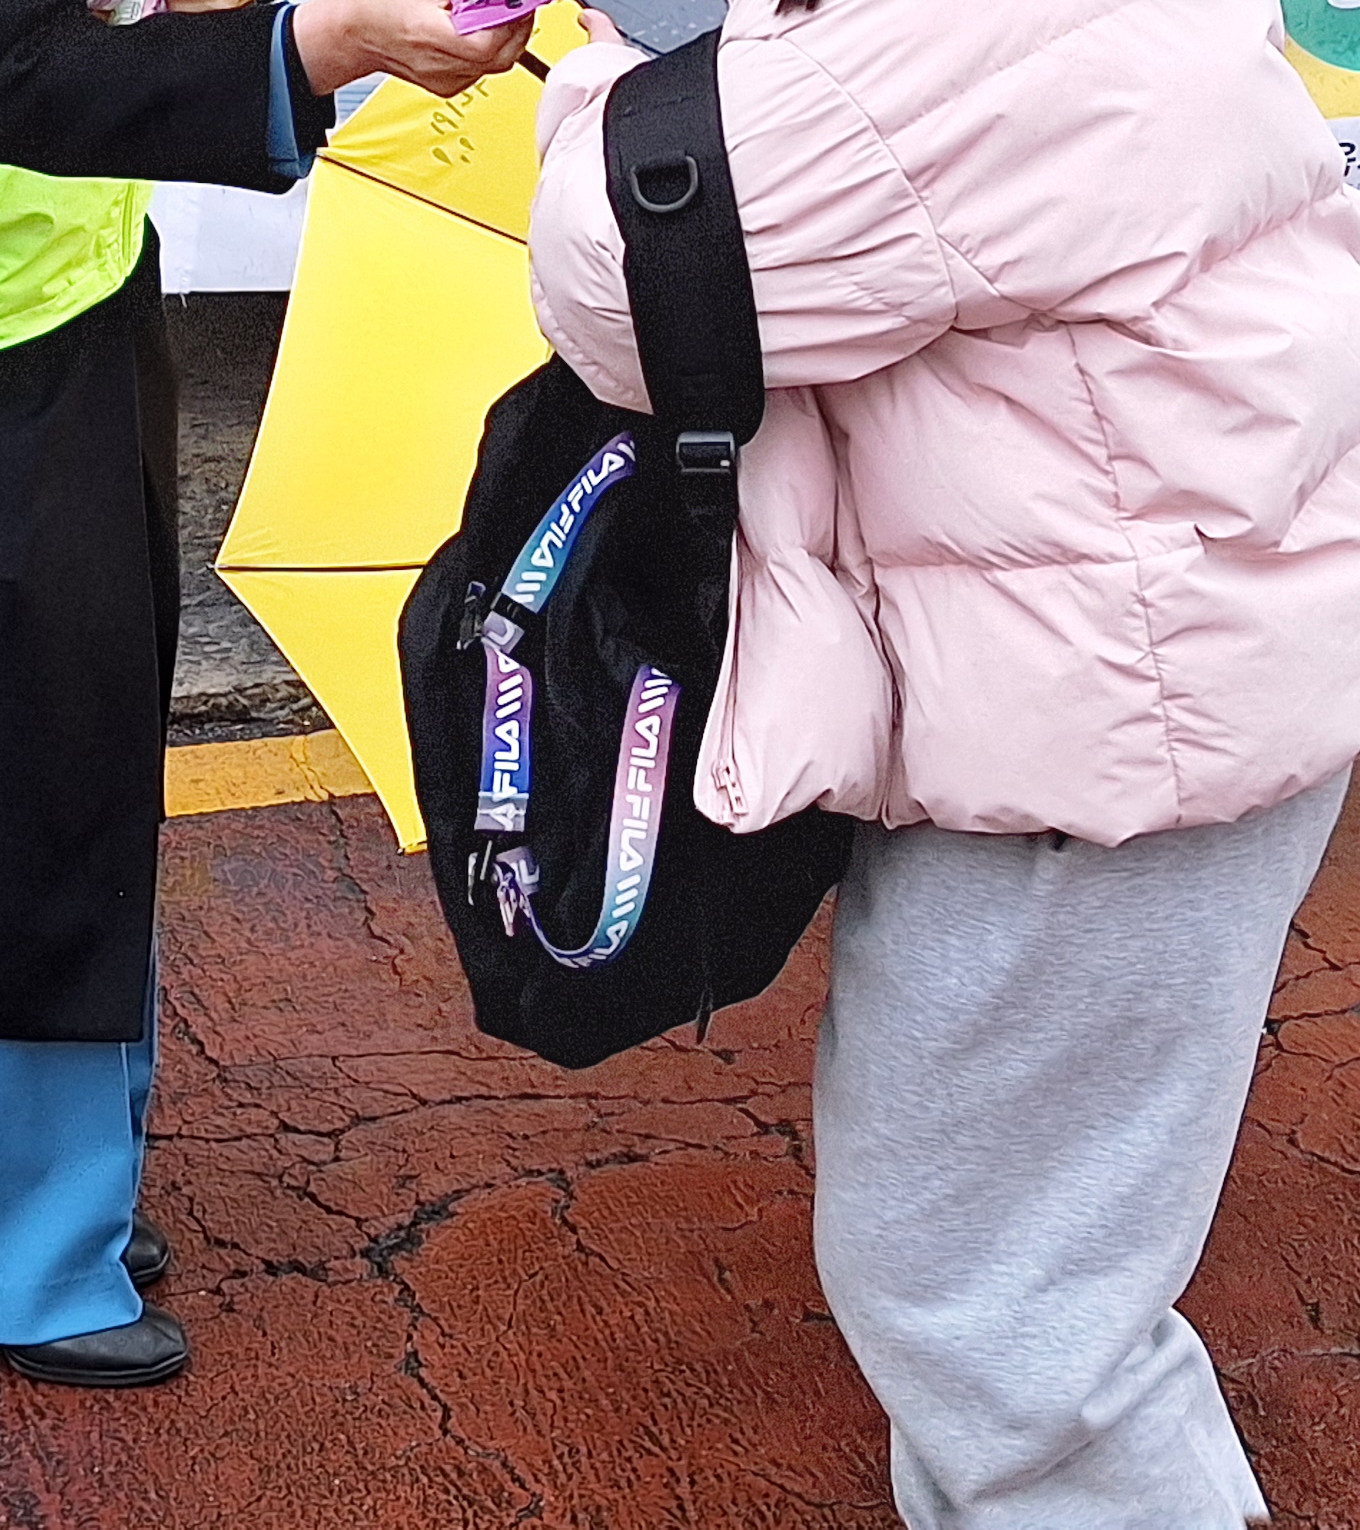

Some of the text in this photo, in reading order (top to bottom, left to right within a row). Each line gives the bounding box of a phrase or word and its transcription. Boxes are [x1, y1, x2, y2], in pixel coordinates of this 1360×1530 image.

[567, 452, 625, 513] FILA
[530, 503, 575, 568] FILA
[492, 718, 521, 801] FILA
[626, 714, 661, 793] FILA
[619, 794, 650, 872] FILA
